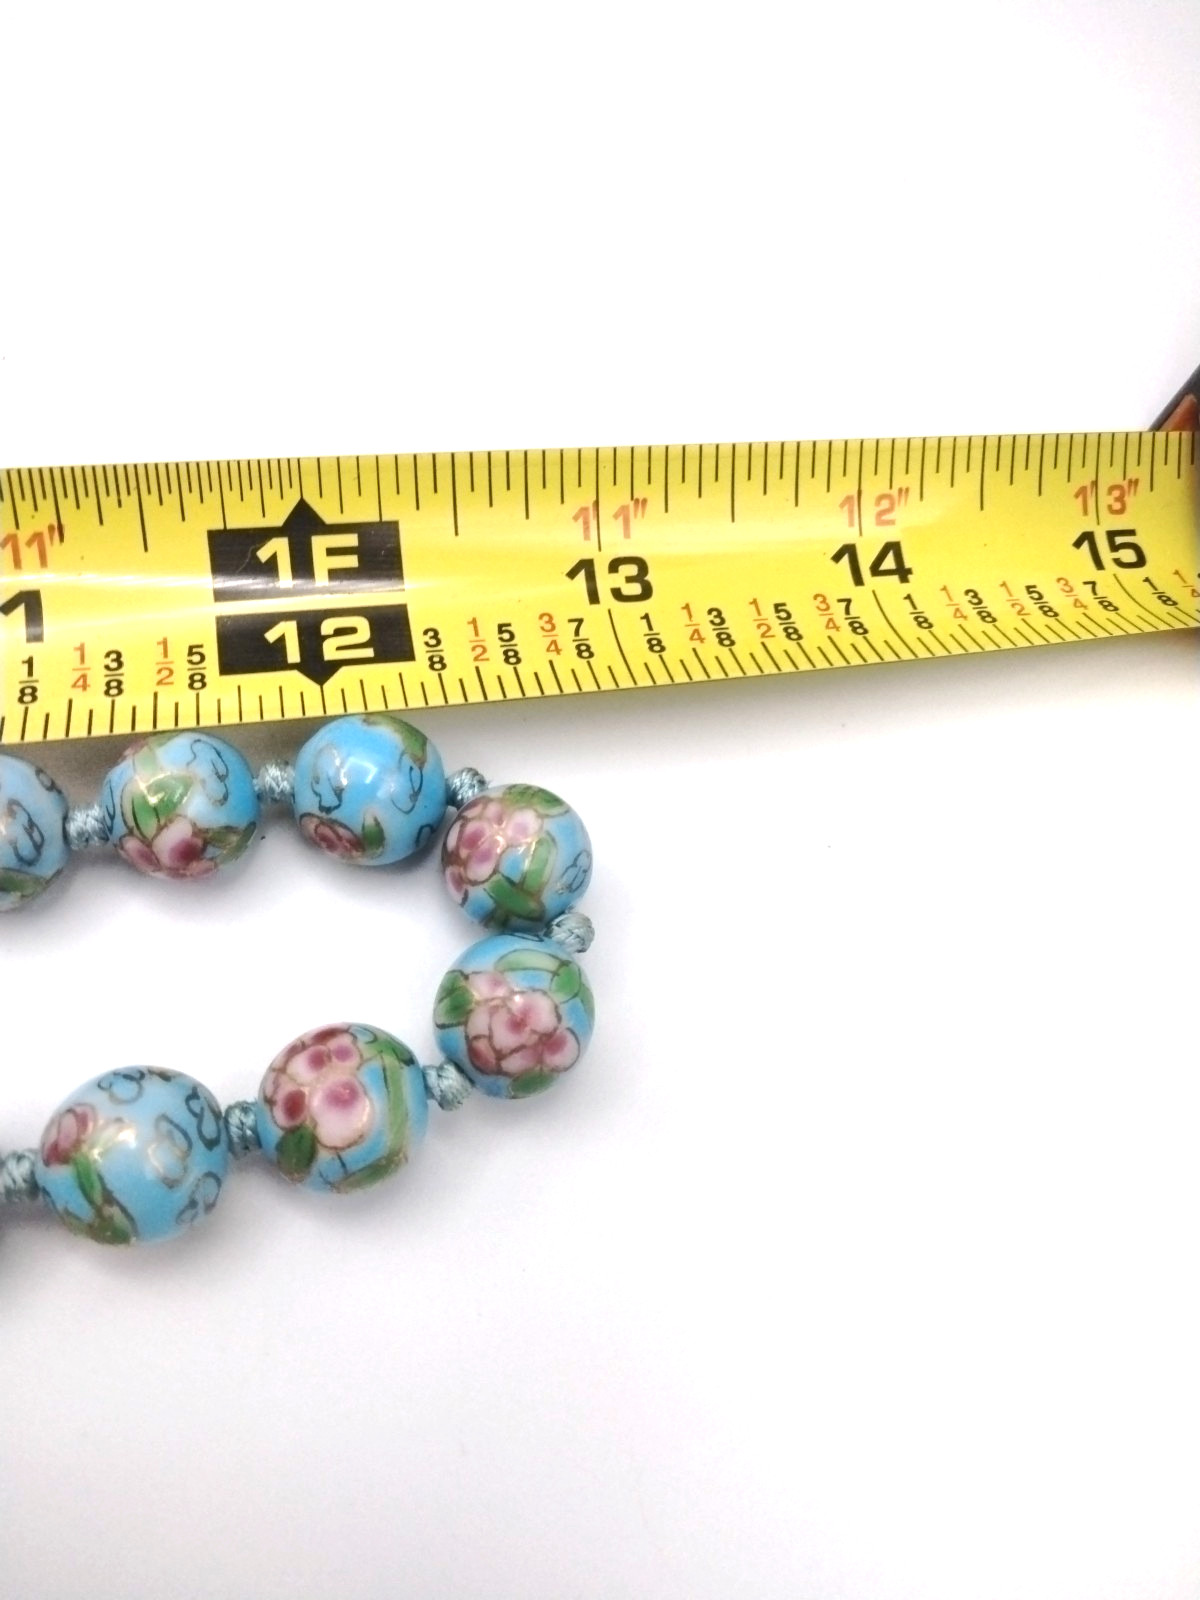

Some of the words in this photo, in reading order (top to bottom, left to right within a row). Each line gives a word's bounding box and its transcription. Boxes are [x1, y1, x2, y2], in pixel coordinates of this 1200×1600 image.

[256, 533, 359, 589] 1F
[830, 540, 914, 587] 14
[1071, 528, 1147, 571] 15
[565, 556, 654, 605] 13
[264, 615, 375, 664] 12
